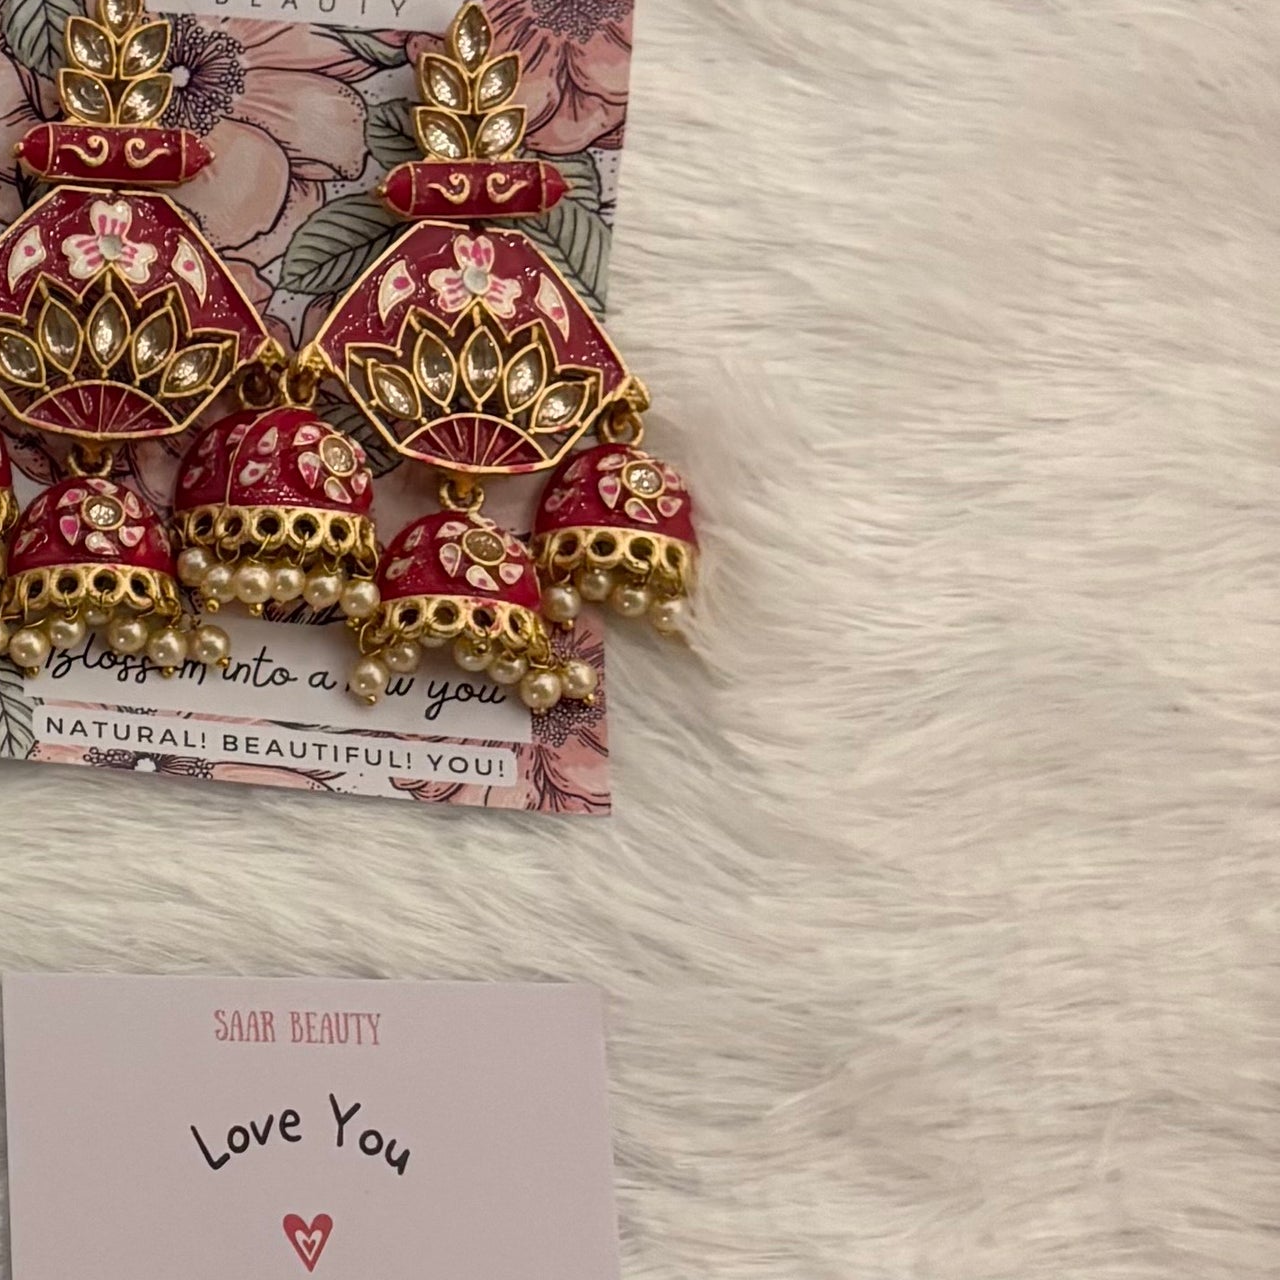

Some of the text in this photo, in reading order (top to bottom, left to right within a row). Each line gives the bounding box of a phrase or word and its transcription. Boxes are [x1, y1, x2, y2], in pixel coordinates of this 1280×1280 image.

[45, 633, 207, 686] Blossm
[308, 670, 338, 691] a
[424, 679, 506, 720] you
[46, 716, 506, 778] NATURAL! BEAUTIFUL! YOU!
[213, 1009, 381, 1045] SAAR BEAUTY
[190, 1093, 411, 1176] Love You
